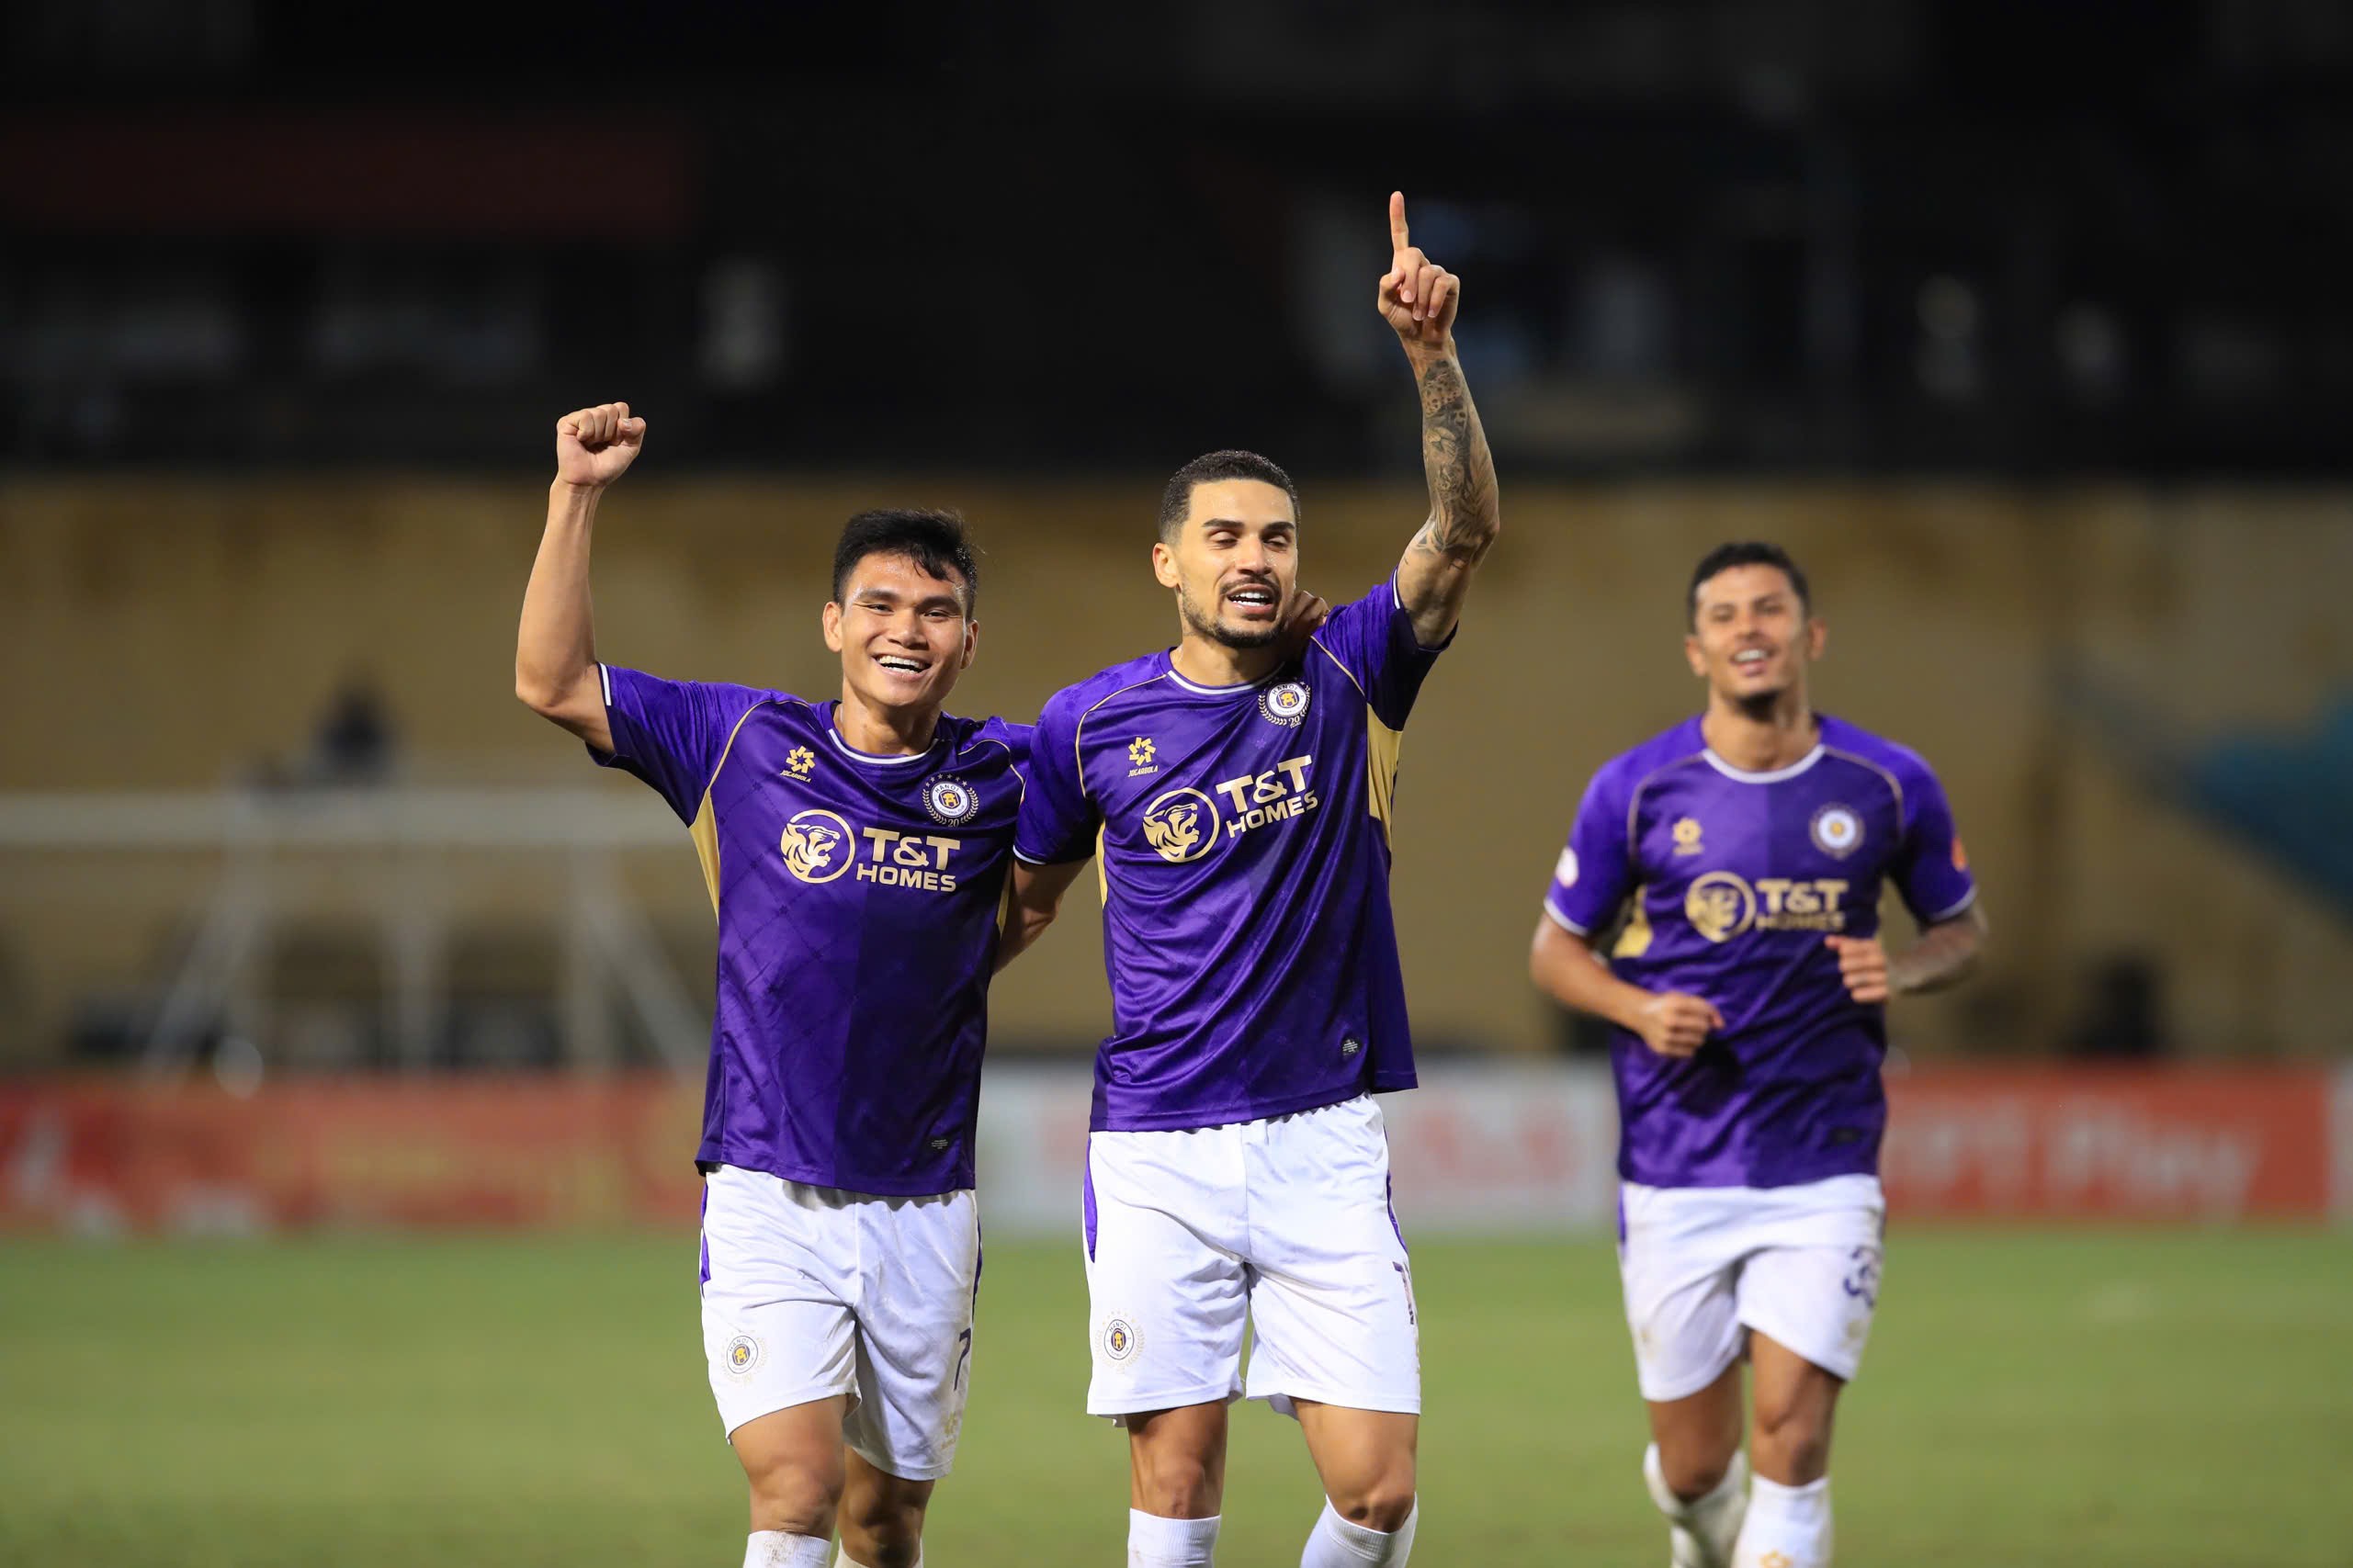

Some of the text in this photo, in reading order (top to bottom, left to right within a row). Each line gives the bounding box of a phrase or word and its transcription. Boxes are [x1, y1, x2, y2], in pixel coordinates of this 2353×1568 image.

[1272, 683, 1298, 695] HANOI
[1288, 716, 1300, 726] 20
[934, 784, 960, 794] HANOI
[1216, 754, 1313, 816] T&T
[947, 818, 960, 828] 20
[1225, 790, 1319, 840] HOMES
[862, 826, 961, 872] T&T
[856, 863, 957, 894] HOMES
[1755, 877, 1850, 915] T&T
[1885, 1099, 2031, 1203] PT
[954, 1326, 972, 1392] 7
